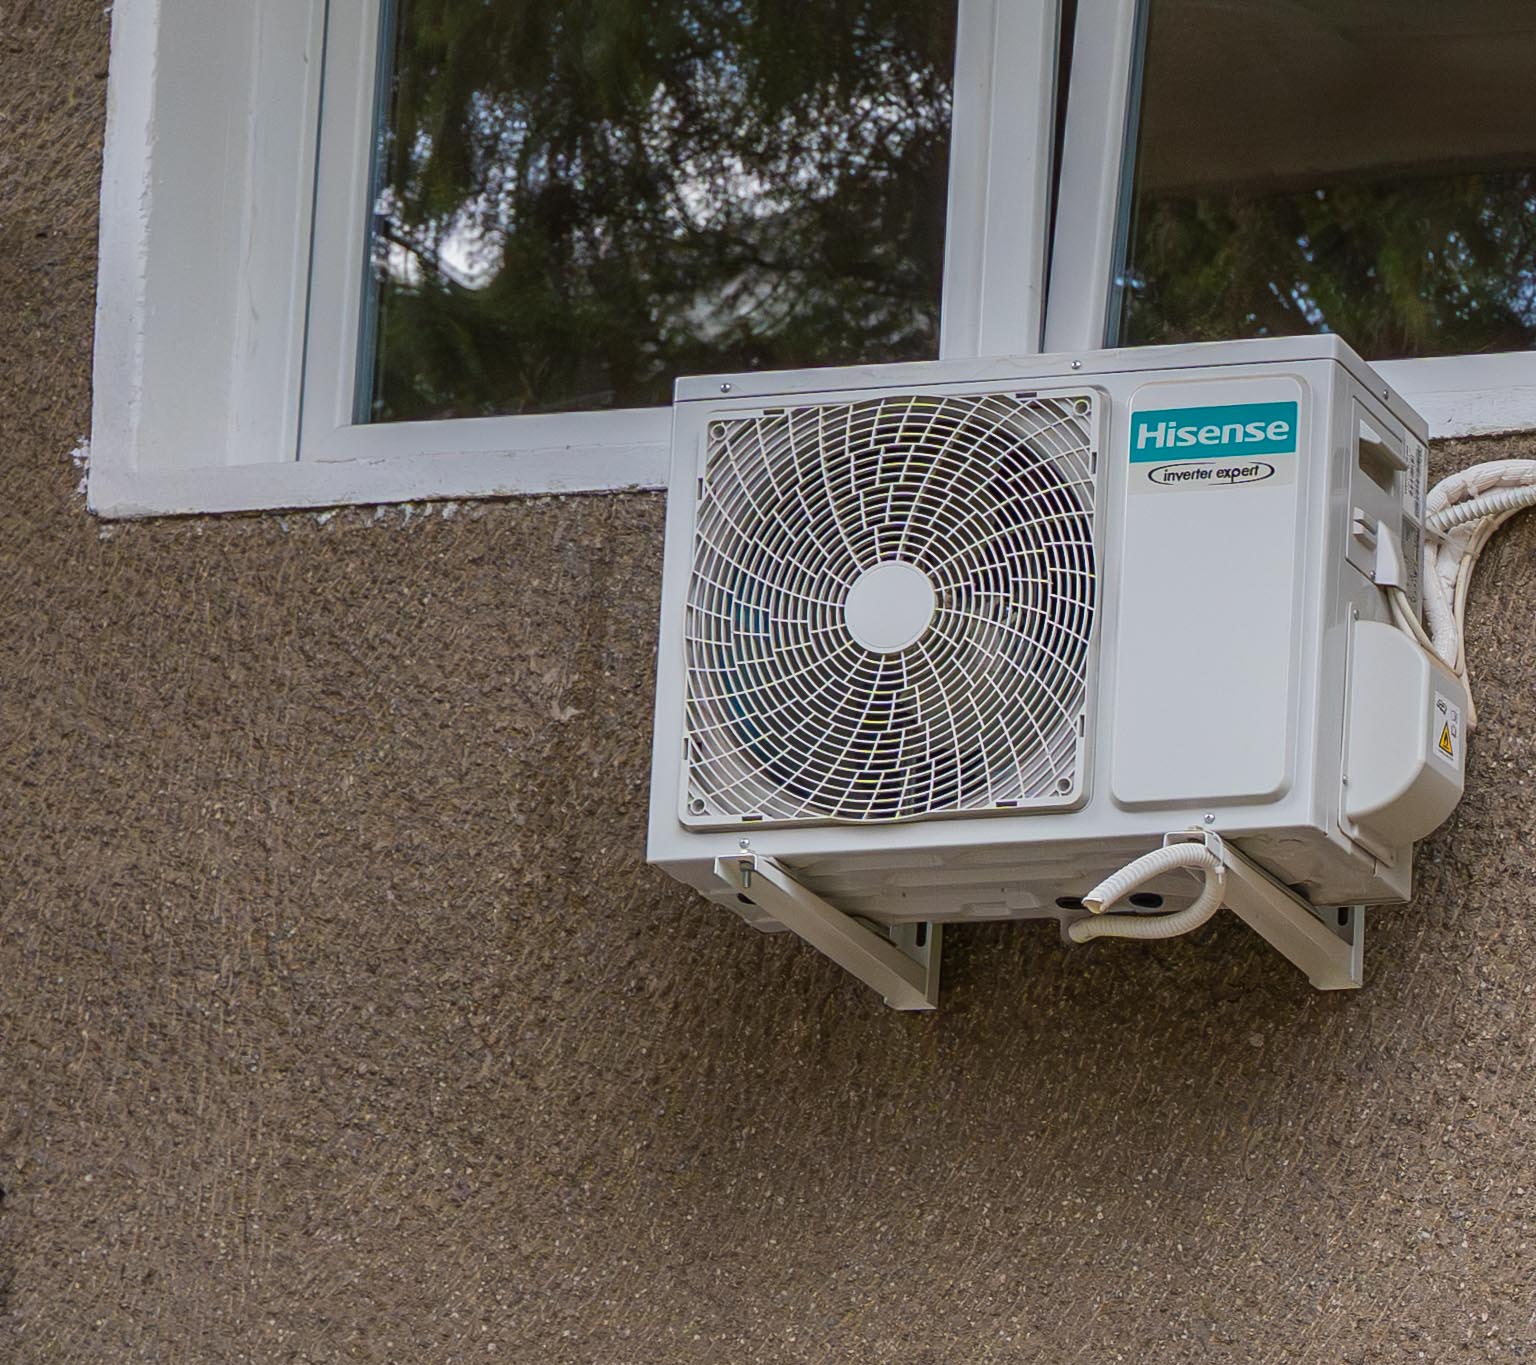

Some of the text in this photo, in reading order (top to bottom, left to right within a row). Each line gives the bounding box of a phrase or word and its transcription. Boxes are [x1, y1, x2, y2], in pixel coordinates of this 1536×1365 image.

[1136, 420, 1290, 449] Hisense
[1163, 464, 1260, 484] inverter expert
